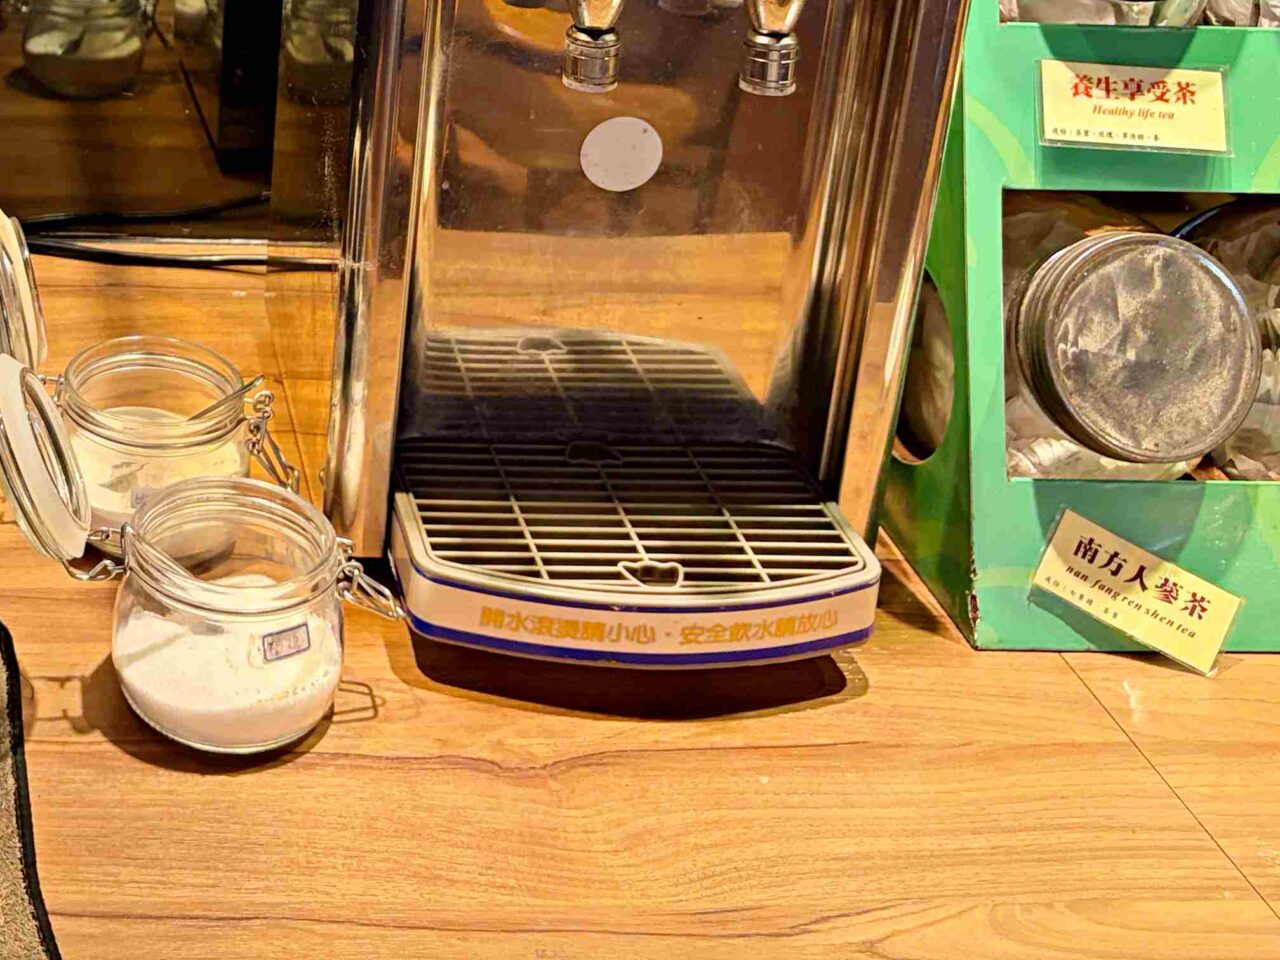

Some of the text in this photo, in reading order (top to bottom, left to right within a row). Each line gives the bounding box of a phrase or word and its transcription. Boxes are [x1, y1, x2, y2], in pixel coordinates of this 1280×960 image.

[1071, 73, 1197, 106] 養生享受茶
[1092, 104, 1175, 120] Healthy life tea
[1065, 564, 1089, 583] nan
[1089, 578, 1120, 601] fang
[1121, 595, 1143, 612] ren
[1144, 607, 1175, 628] shen
[1175, 621, 1197, 640] tea
